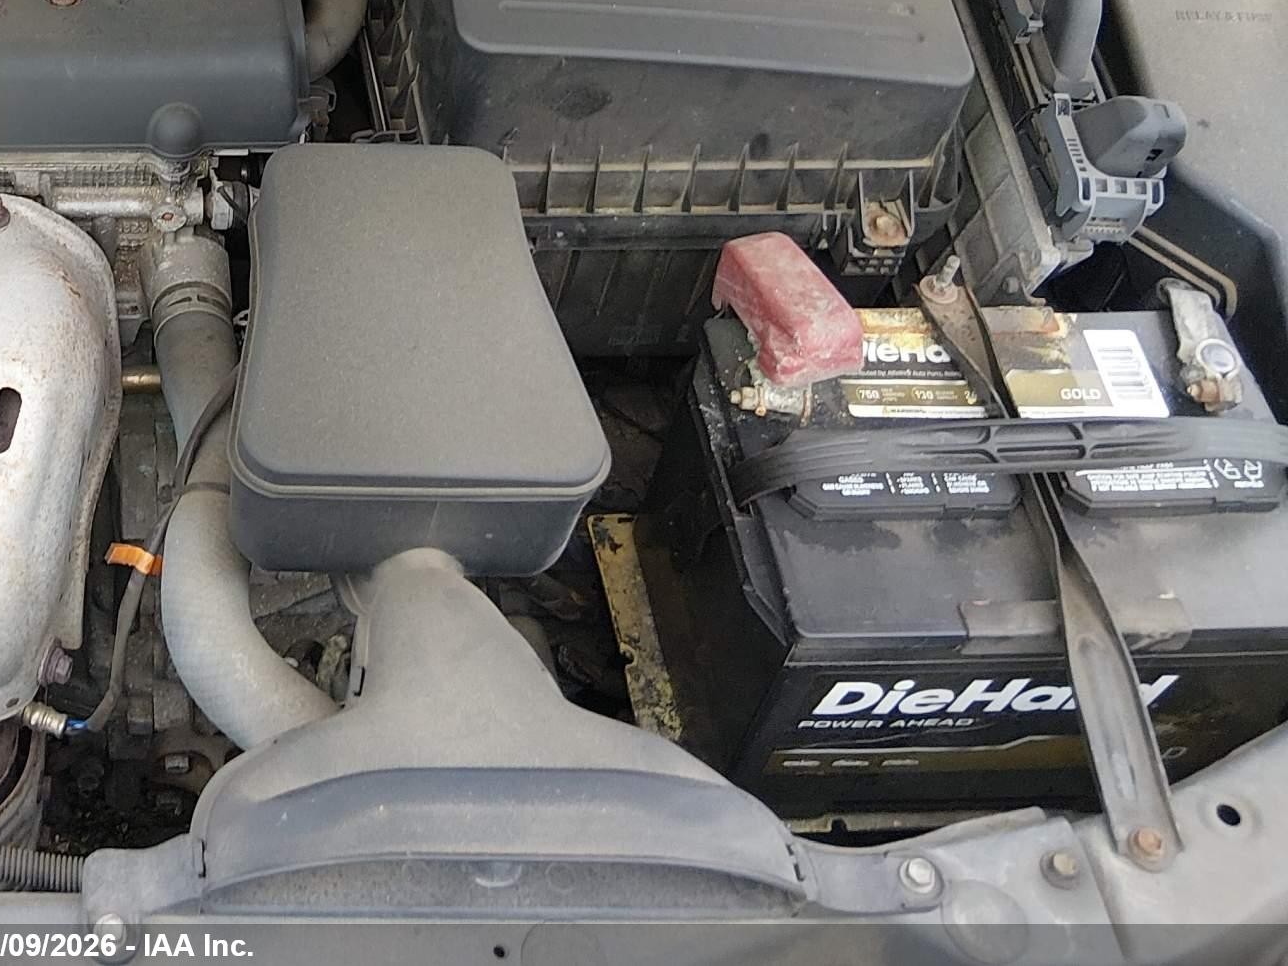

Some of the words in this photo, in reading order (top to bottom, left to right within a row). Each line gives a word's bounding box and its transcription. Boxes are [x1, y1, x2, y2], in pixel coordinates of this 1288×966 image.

[1060, 387, 1101, 400] GOLD
[797, 720, 882, 729] POWER
[889, 717, 975, 728] AHEAD
